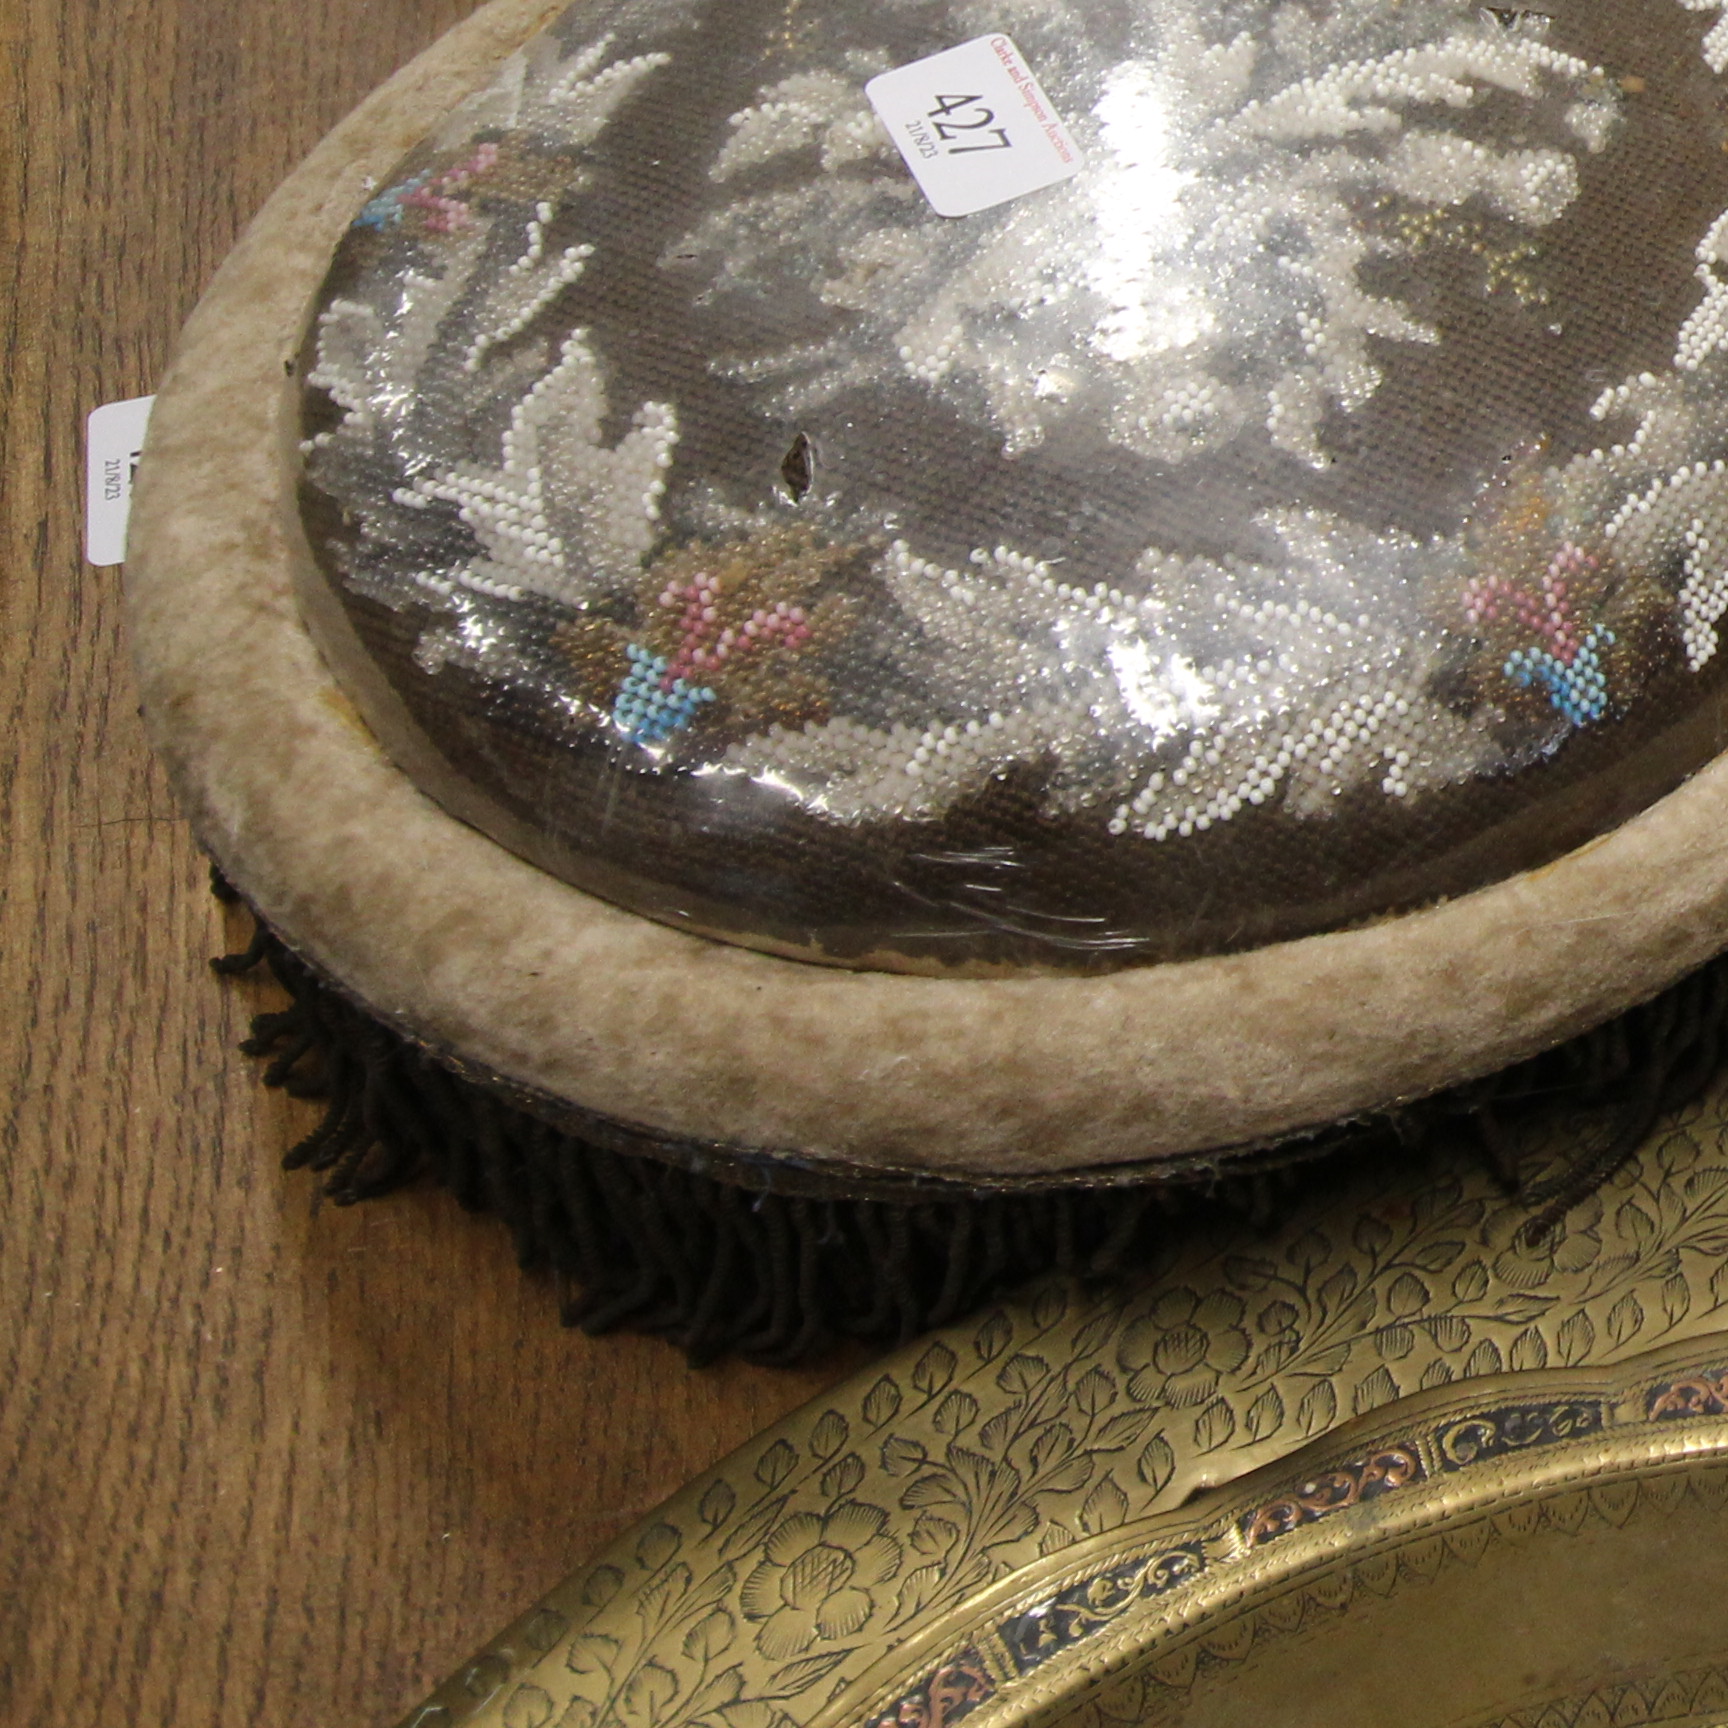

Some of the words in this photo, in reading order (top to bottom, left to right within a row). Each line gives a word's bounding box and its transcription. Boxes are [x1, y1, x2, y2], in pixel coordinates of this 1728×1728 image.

[927, 95, 1012, 155] 427
[990, 36, 1012, 66] Clarke
[1008, 66, 1029, 84] and
[1019, 82, 1048, 123] Simpson
[1042, 122, 1074, 163] Auctions
[905, 120, 939, 160] 21/8/23
[105, 459, 121, 501] 21/8/23
